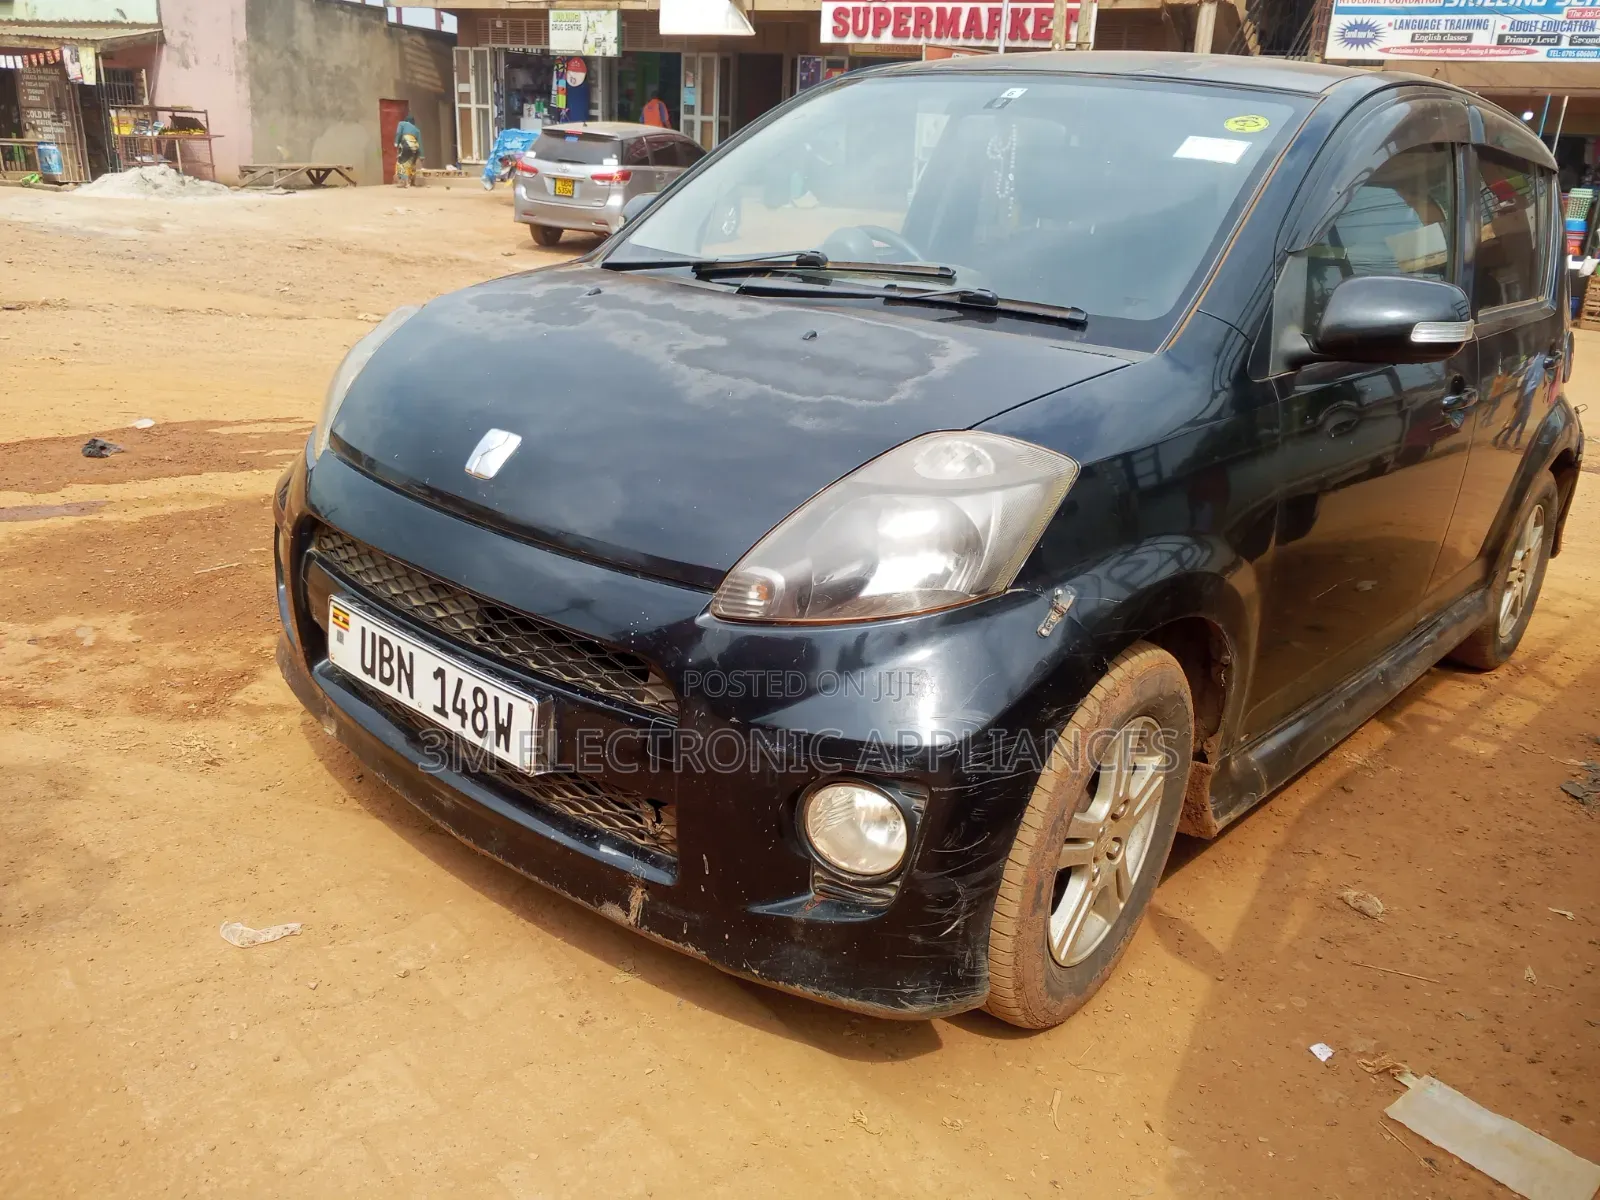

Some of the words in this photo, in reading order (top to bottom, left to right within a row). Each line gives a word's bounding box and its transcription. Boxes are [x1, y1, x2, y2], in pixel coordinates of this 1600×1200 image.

[832, 6, 1081, 41] SUPERMARKET
[1393, 19, 1442, 31] LANGUAGE
[1443, 19, 1490, 31] TRAINING
[1508, 20, 1540, 32] ADULT
[1540, 20, 1597, 33] EDUCATION
[1414, 33, 1442, 43] English
[1442, 33, 1468, 42] classes
[1504, 36, 1536, 46] Primary
[1536, 35, 1558, 44] Level
[359, 625, 415, 700] UBN
[431, 666, 514, 754] 148W
